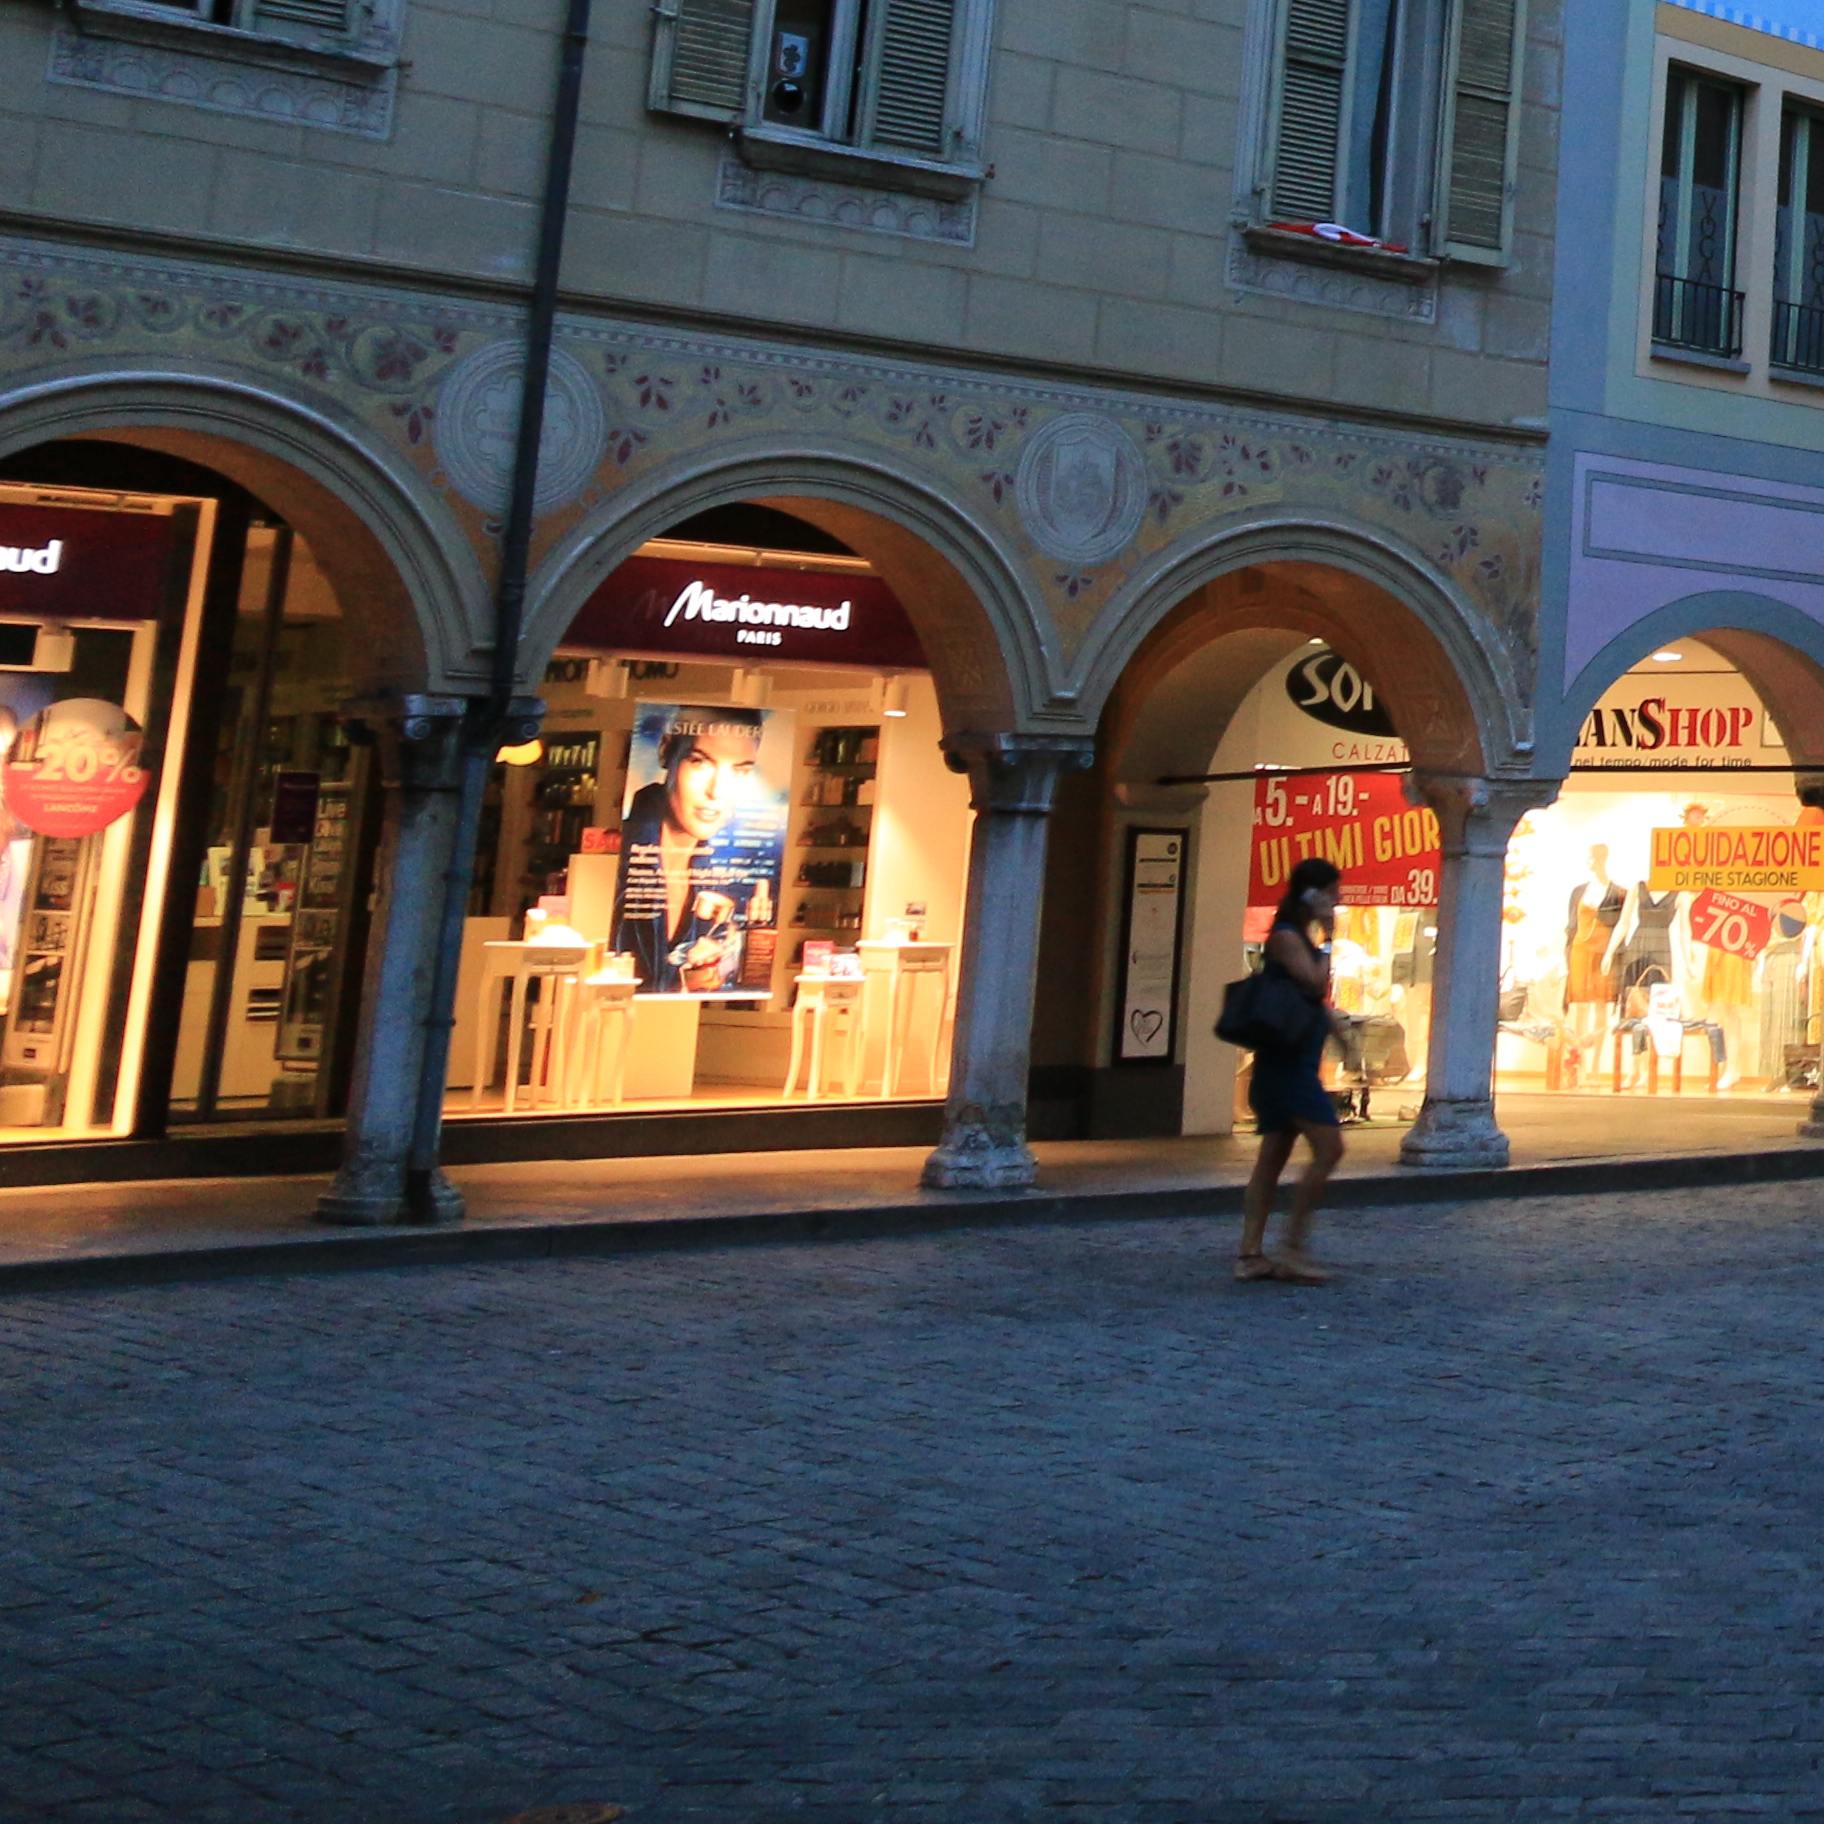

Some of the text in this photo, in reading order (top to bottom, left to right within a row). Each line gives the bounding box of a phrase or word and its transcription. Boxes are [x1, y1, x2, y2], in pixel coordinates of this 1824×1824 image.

[664, 581, 850, 630] Marionnaud
[737, 629, 782, 646] PARIS
[1574, 697, 1754, 751] ANSHOP
[10, 742, 143, 785] -20%
[1696, 755, 1715, 767] for
[1722, 756, 1752, 767] time
[1312, 793, 1323, 816] A
[1259, 821, 1365, 887] ULTIMI
[1655, 831, 1821, 868] LIQUIDAZIONE
[1675, 872, 1798, 887] DI FINE STAGIONE
[1711, 892, 1758, 918] FINO AL
